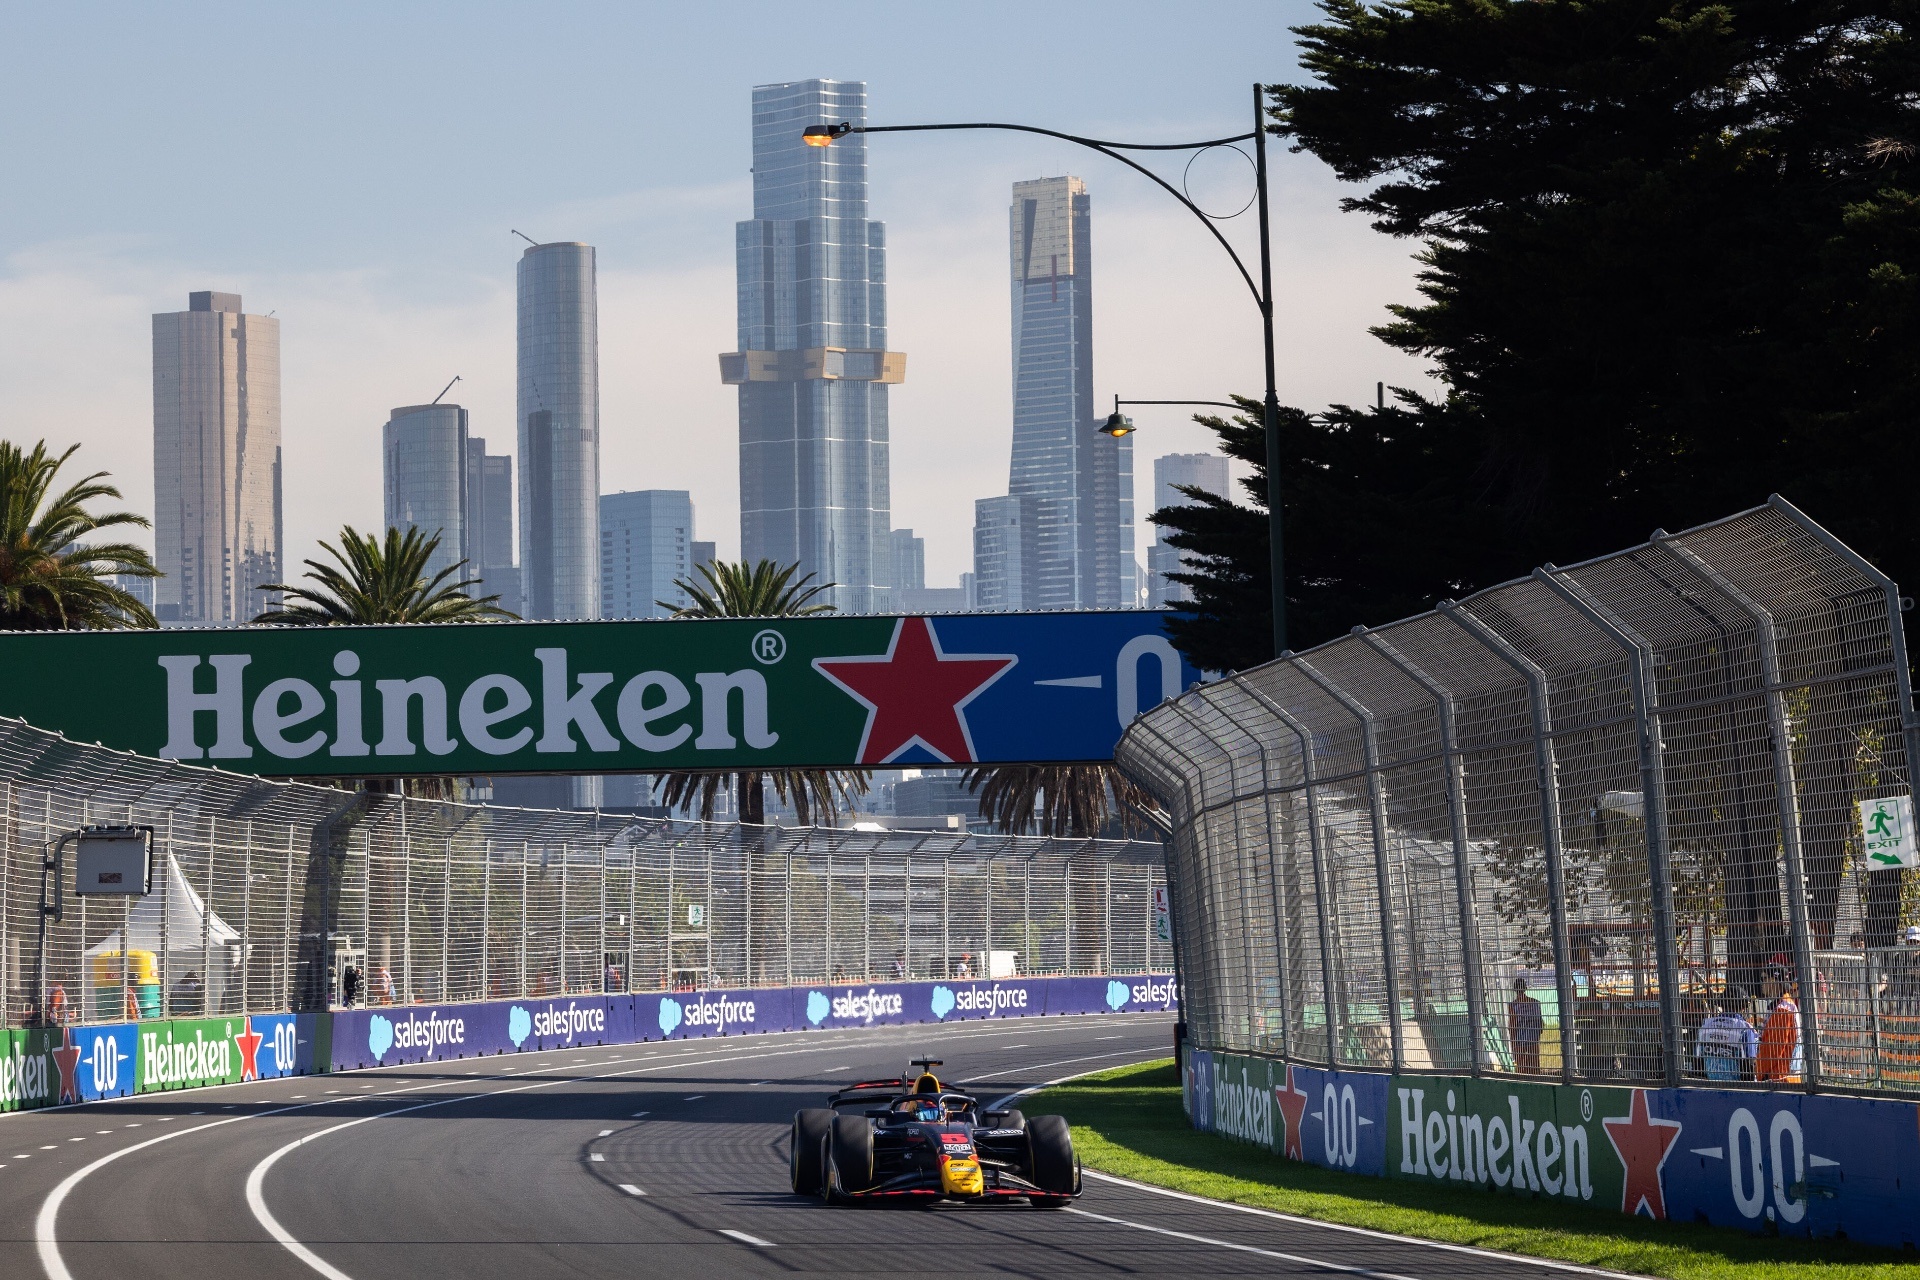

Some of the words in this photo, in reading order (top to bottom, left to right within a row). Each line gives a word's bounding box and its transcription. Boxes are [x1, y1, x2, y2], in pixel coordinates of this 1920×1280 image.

[1868, 840, 1901, 850] EXIT
[684, 995, 755, 1032] salesforce
[832, 988, 902, 1022] salesforce
[956, 984, 1027, 1015] salesforce
[395, 1011, 464, 1057] salesforce
[534, 1001, 604, 1042] salesforce
[93, 1035, 117, 1092] 0.0
[274, 1022, 296, 1070] 0.0
[1323, 1082, 1357, 1168] 0.0
[1728, 1107, 1806, 1223] 0.0
